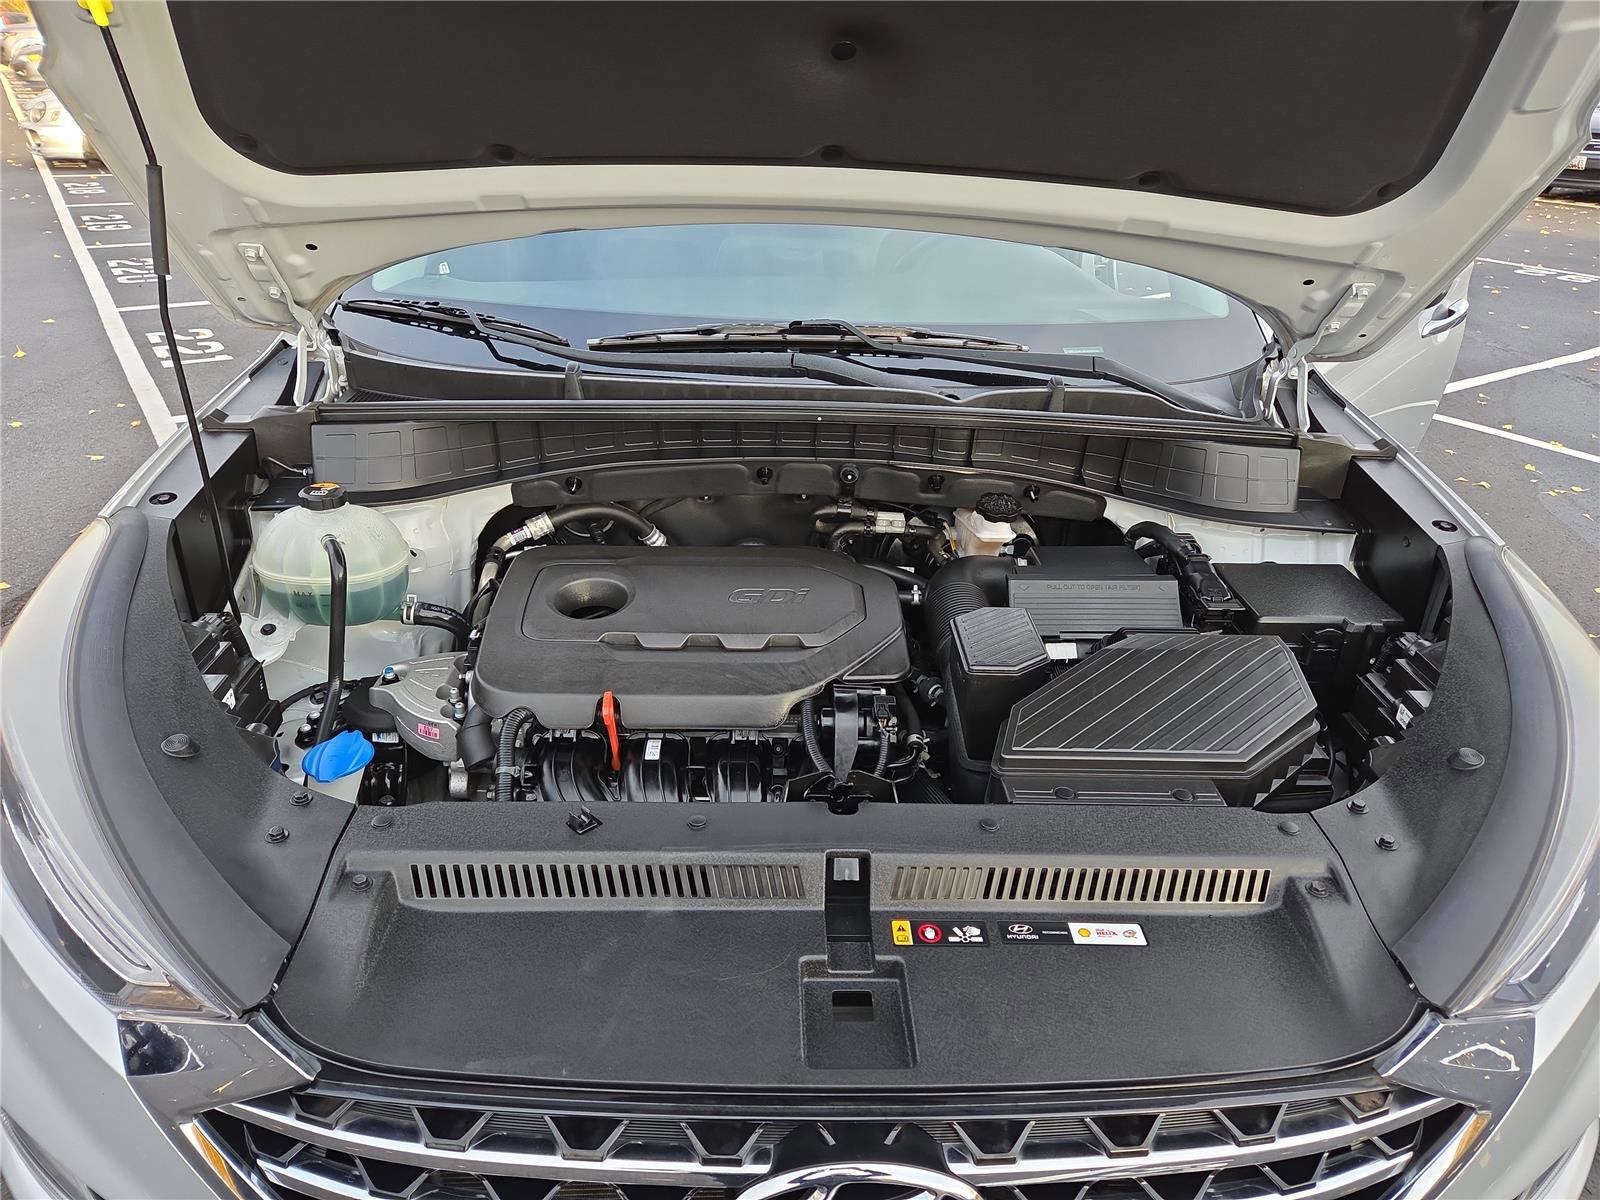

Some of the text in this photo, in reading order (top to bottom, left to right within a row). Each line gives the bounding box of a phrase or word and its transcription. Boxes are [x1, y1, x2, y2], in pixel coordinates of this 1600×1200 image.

[63, 182, 106, 195] 218
[80, 214, 132, 231] 219
[107, 257, 172, 283] 220
[145, 328, 234, 368] 221
[1046, 583, 1063, 591] PULL
